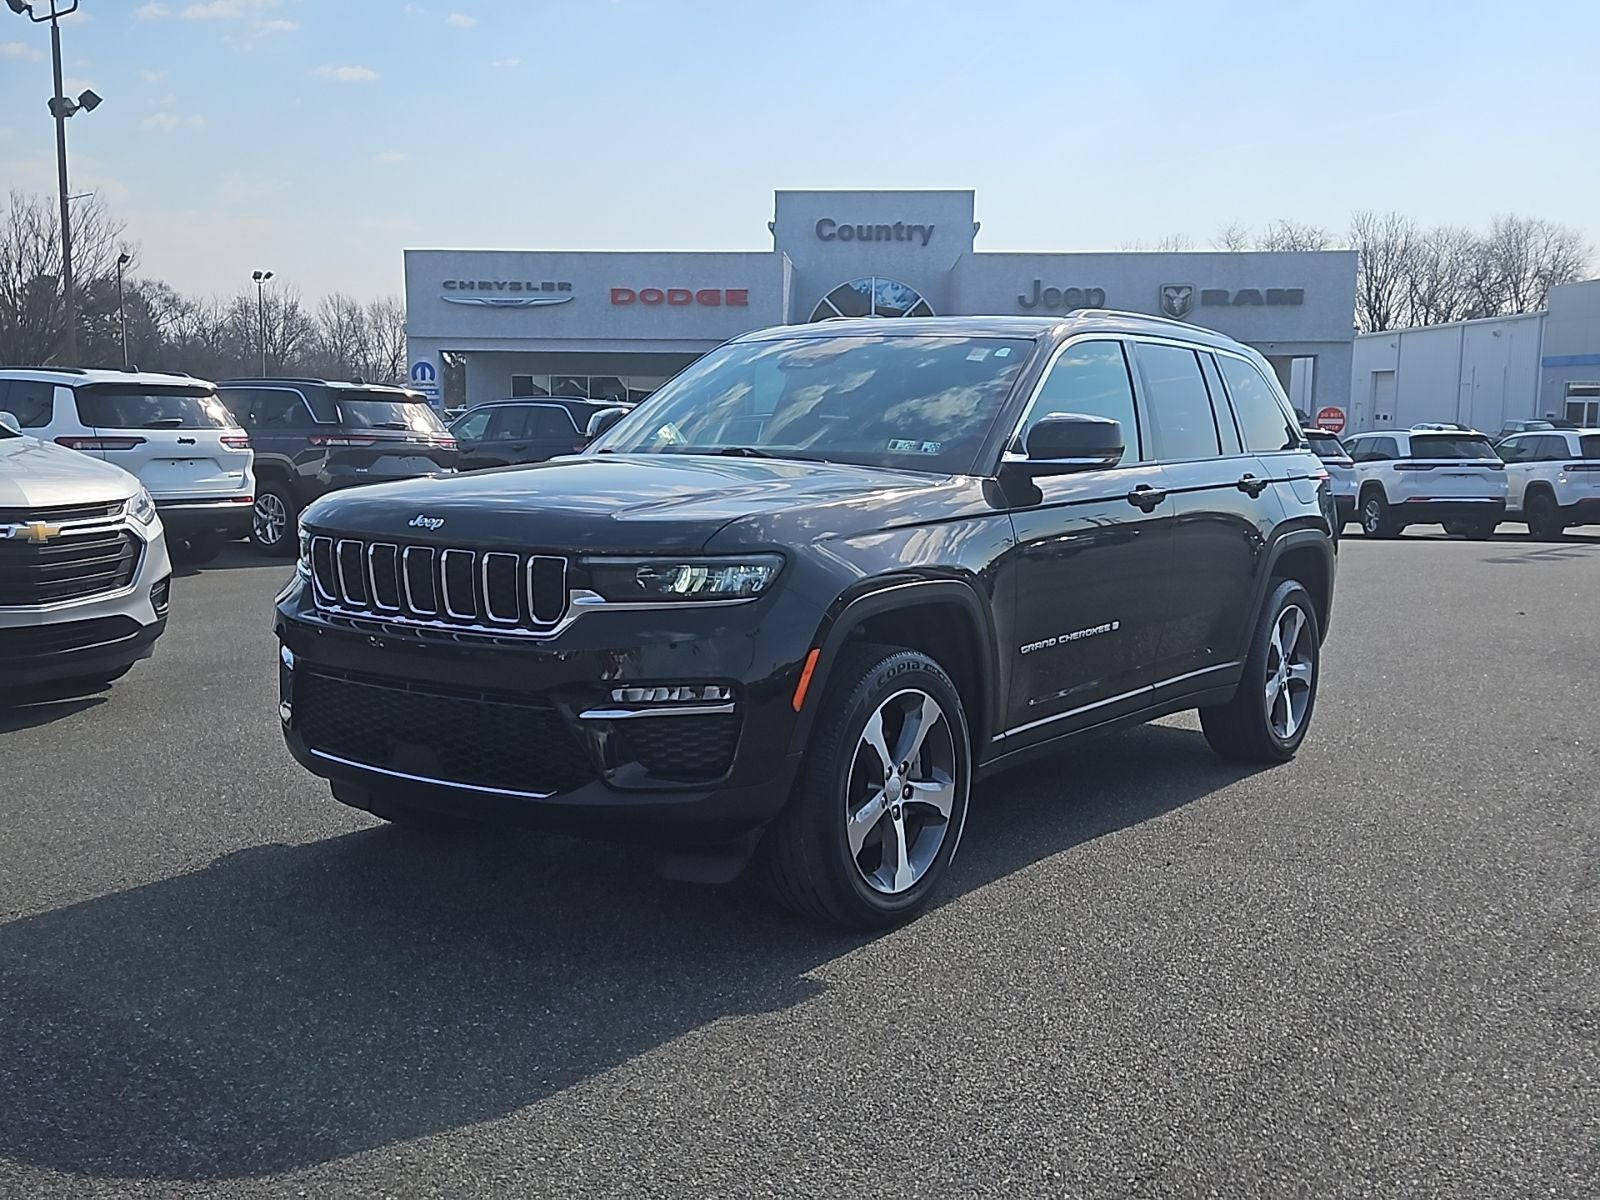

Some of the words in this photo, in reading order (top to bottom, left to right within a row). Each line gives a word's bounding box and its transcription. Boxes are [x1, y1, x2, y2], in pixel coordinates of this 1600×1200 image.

[815, 217, 935, 247] Country
[442, 280, 573, 292] CHRYSLER
[1018, 279, 1106, 309] Jeep
[610, 287, 749, 306] DODGE
[1201, 288, 1305, 306] RAM
[408, 514, 445, 531] Jeep
[1020, 637, 1057, 654] GRAND
[1058, 623, 1111, 643] CHEROKEE
